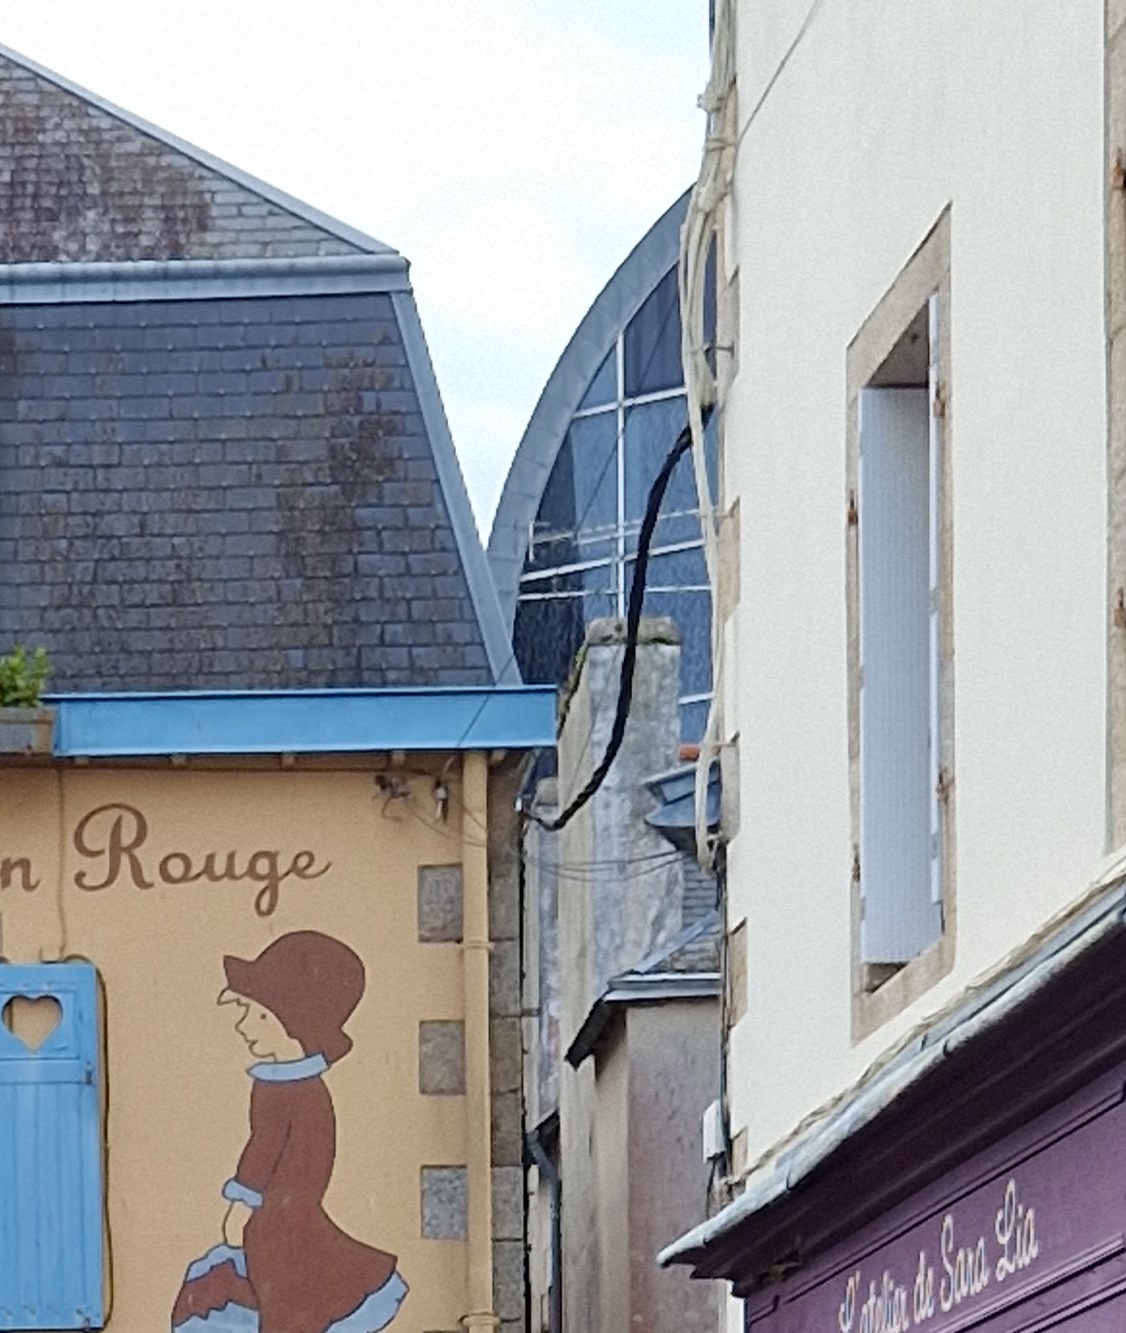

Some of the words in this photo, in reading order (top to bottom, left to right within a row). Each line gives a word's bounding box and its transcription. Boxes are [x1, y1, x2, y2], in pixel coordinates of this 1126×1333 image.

[72, 802, 332, 919] Rouge
[912, 1251, 935, 1325] de
[940, 1213, 990, 1313] Sara
[994, 1178, 1039, 1282] Lia
